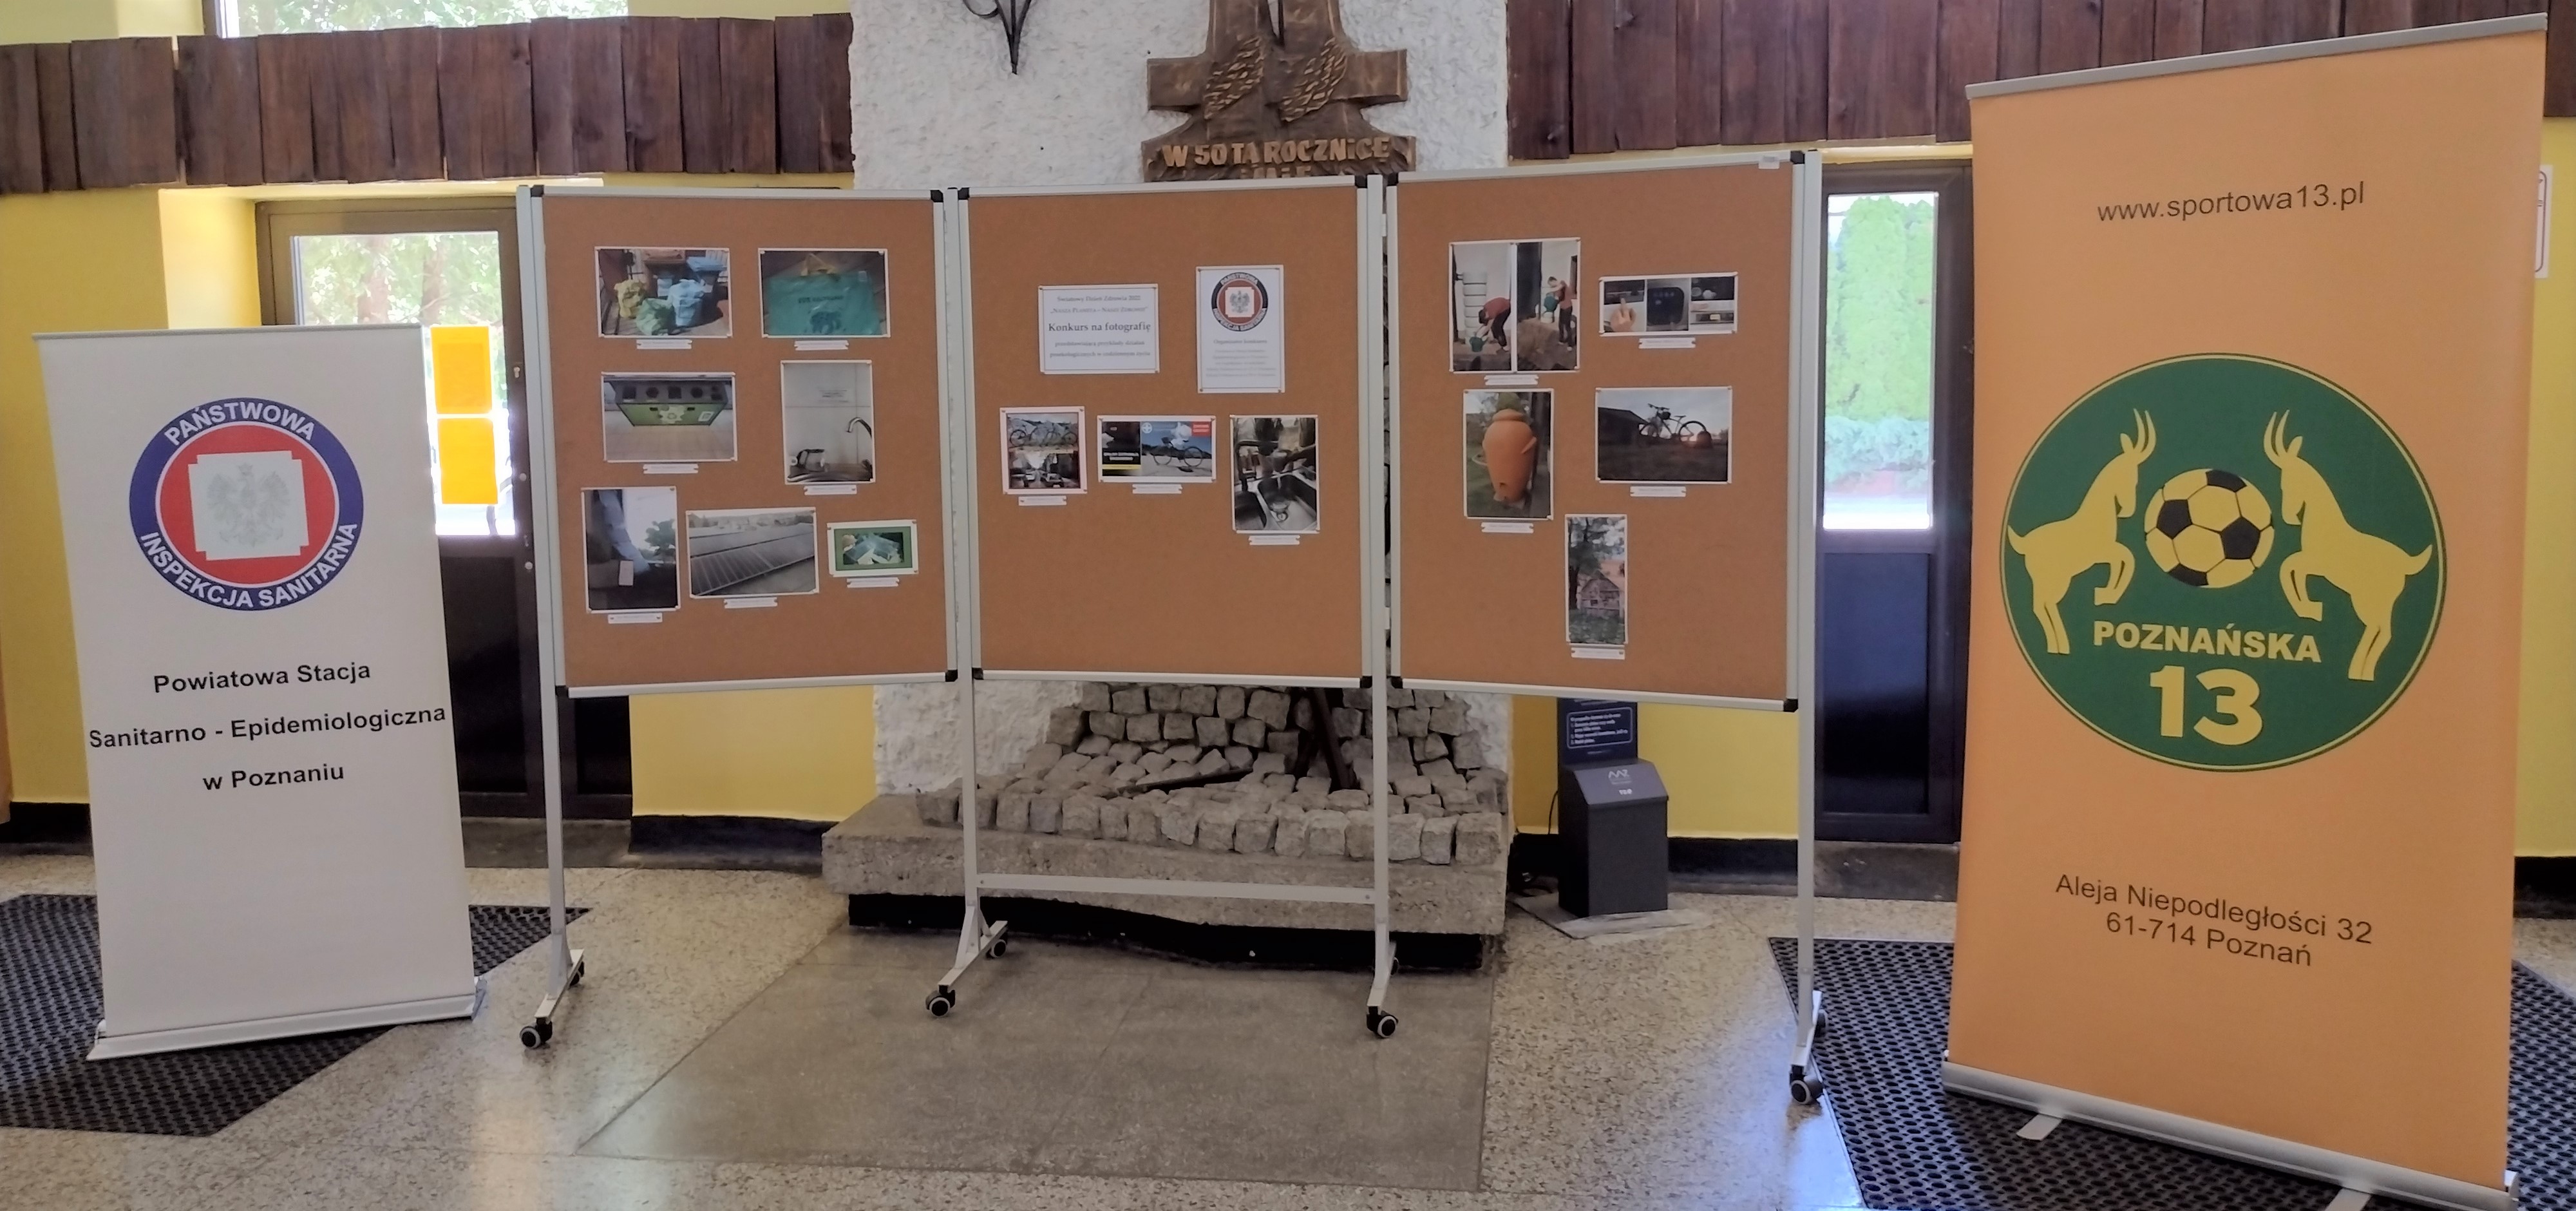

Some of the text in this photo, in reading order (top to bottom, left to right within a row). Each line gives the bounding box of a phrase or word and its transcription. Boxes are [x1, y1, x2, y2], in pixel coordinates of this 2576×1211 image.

[1162, 144, 1188, 167] W
[1194, 143, 1227, 166] 50
[2097, 180, 2365, 222] www.sportowa13.pl
[1048, 323, 1088, 332] Konkurs
[1104, 321, 1151, 333] fotografię
[164, 401, 316, 446] PAŃSTWOWA
[140, 523, 358, 608] INSPEKCJA SANITARNA
[2093, 620, 2322, 663] POZNAŃSKA
[153, 662, 371, 693] Powiatowa Stacja
[2148, 664, 2264, 746] 13
[89, 724, 207, 749] Sanitarno
[231, 707, 446, 741] Epidemiologiczna
[202, 763, 345, 790] w Poznaniu
[2055, 874, 2372, 944] Aleja Niepodległości 32
[2106, 912, 2311, 966] 61-714 Poznań
